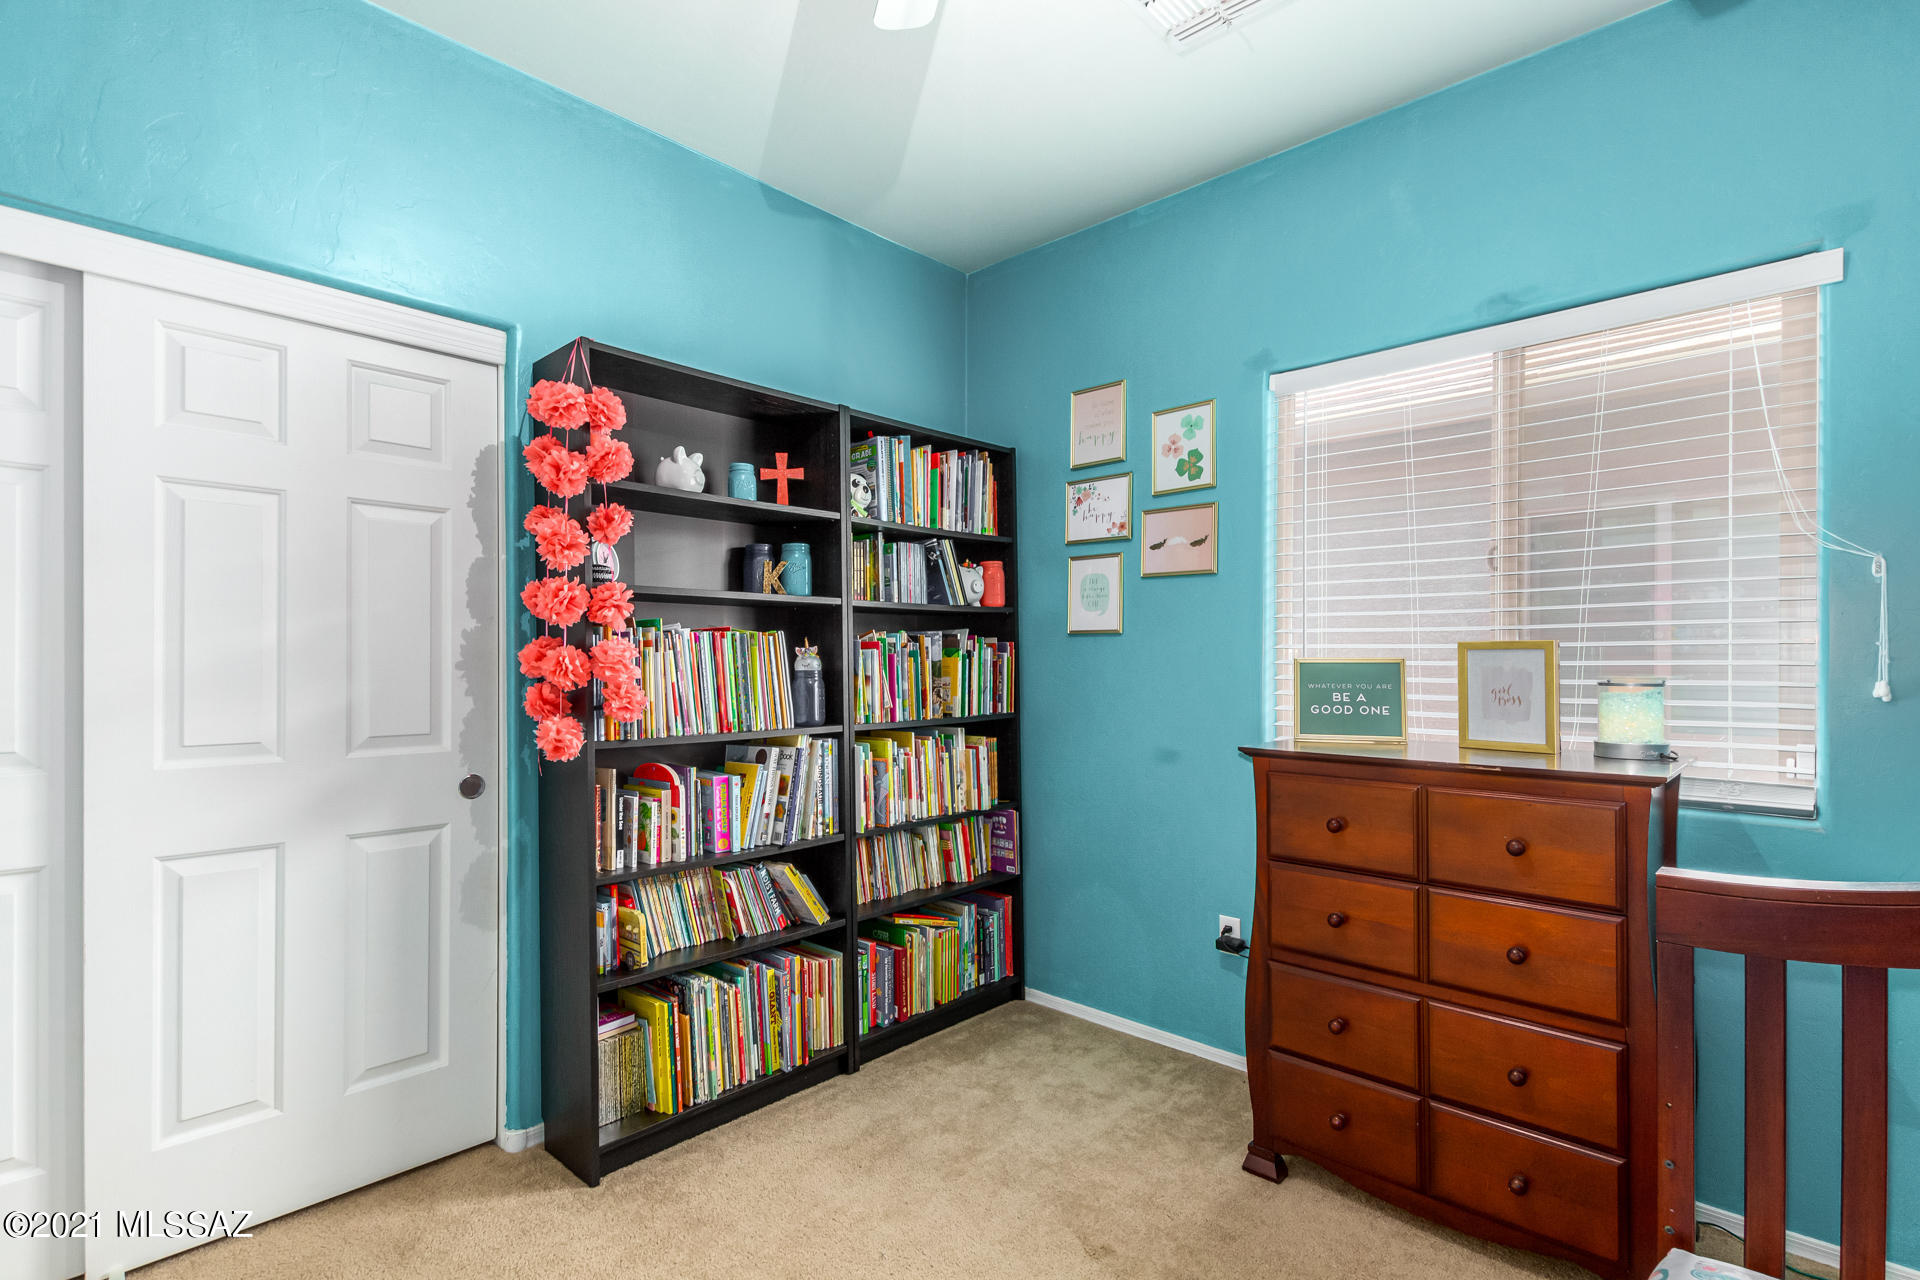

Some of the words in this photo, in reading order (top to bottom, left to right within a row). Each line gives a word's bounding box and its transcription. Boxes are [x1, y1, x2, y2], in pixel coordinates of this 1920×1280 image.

[1078, 431, 1115, 447] happy
[1082, 510, 1113, 524] happy
[763, 560, 788, 595] K
[1332, 692, 1351, 702] BE
[1356, 692, 1367, 702] A
[1491, 682, 1513, 703] girl
[1310, 705, 1353, 715] GOOD
[1359, 705, 1391, 716] ONE
[760, 869, 774, 895] NOISY
[770, 893, 781, 915] FARM
[768, 991, 777, 1025] GIANT
